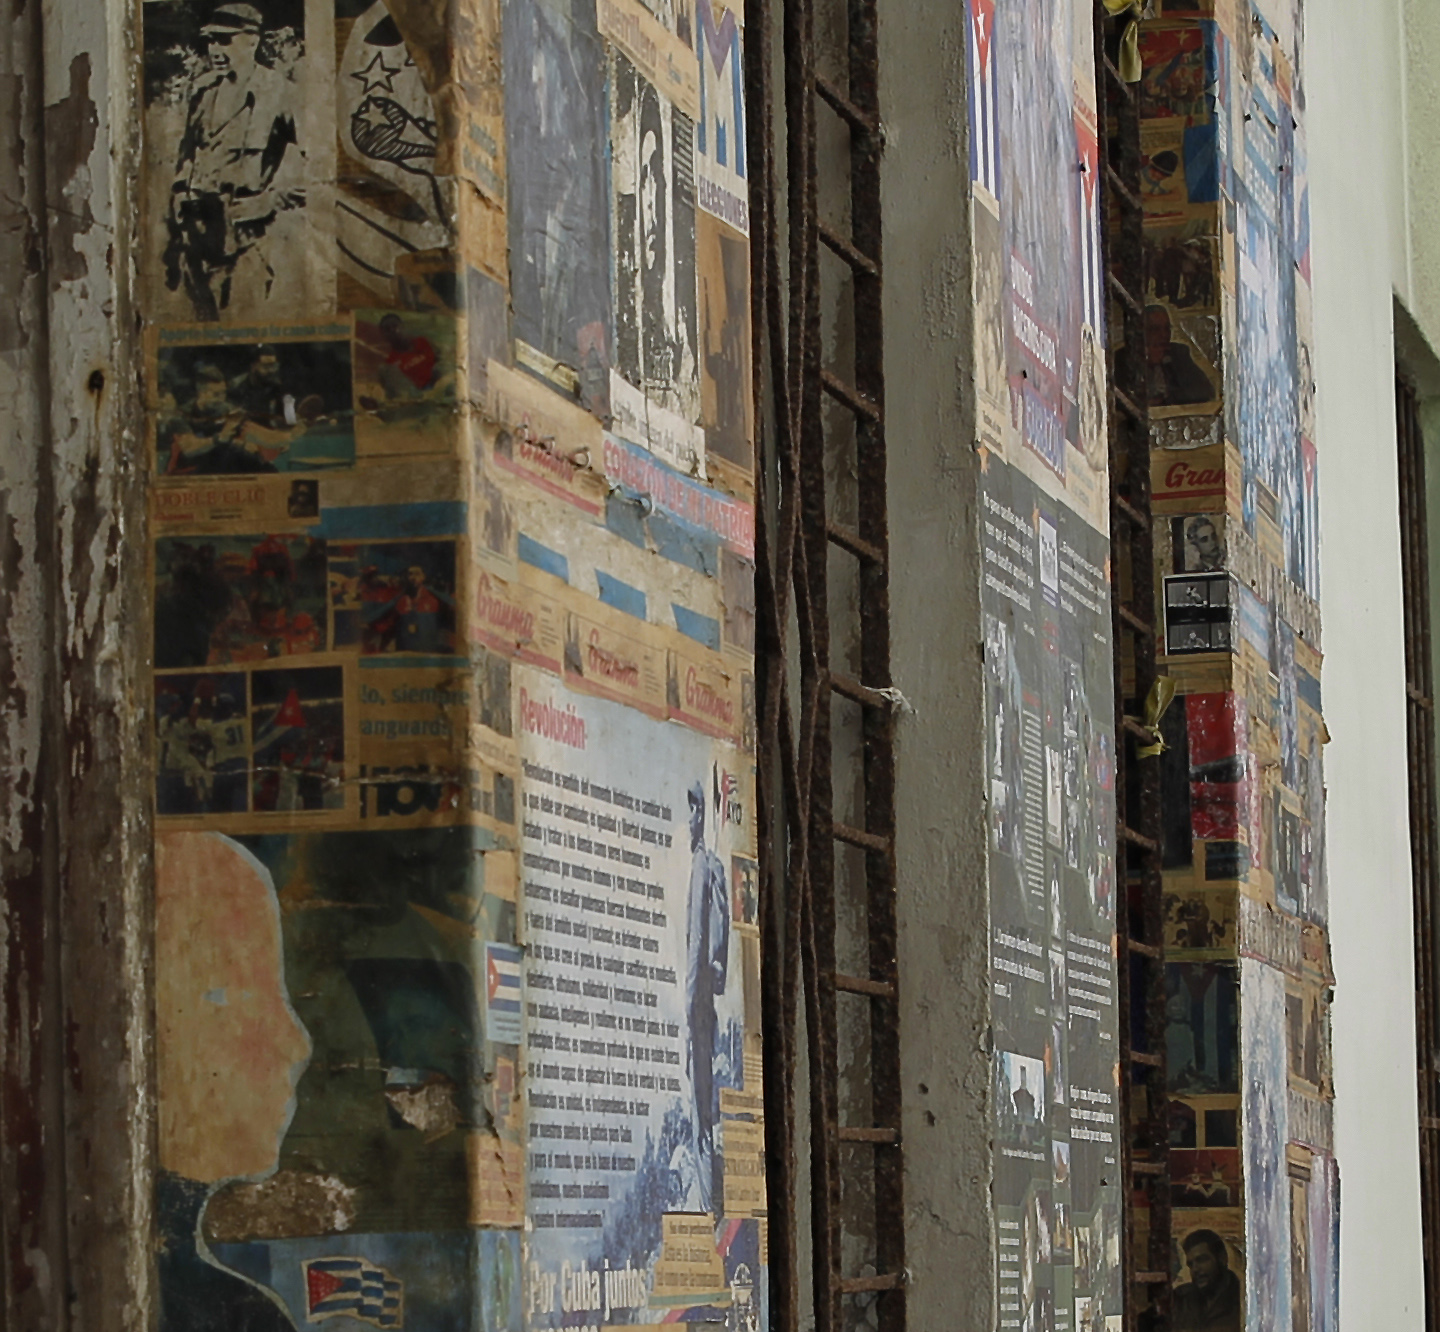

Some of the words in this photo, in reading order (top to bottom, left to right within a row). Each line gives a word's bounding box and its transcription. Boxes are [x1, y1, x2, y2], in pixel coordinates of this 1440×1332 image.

[519, 687, 586, 750] Revolución
[529, 1264, 557, 1321] Por
[561, 1259, 601, 1313] Cuba
[603, 1257, 647, 1322] juntos
